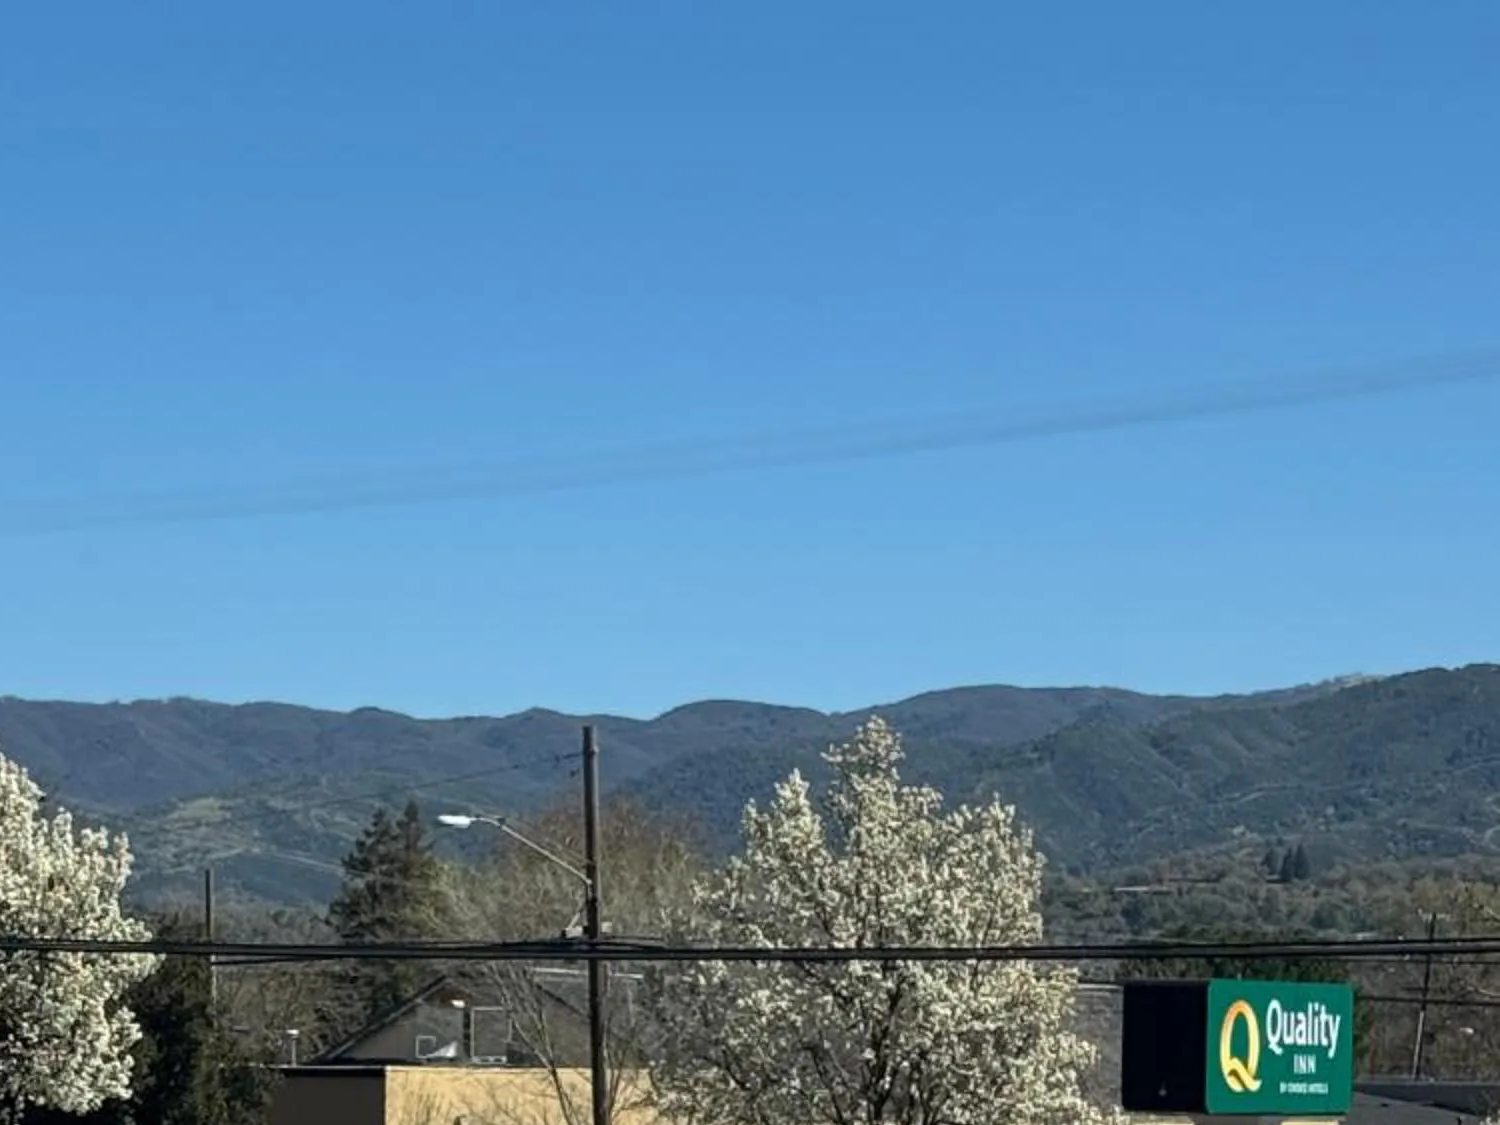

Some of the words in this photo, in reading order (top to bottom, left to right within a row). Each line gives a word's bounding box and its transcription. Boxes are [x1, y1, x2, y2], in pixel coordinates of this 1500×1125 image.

[1220, 1000, 1262, 1093] Q
[1266, 999, 1341, 1059] Quality
[1293, 1054, 1316, 1074] INN
